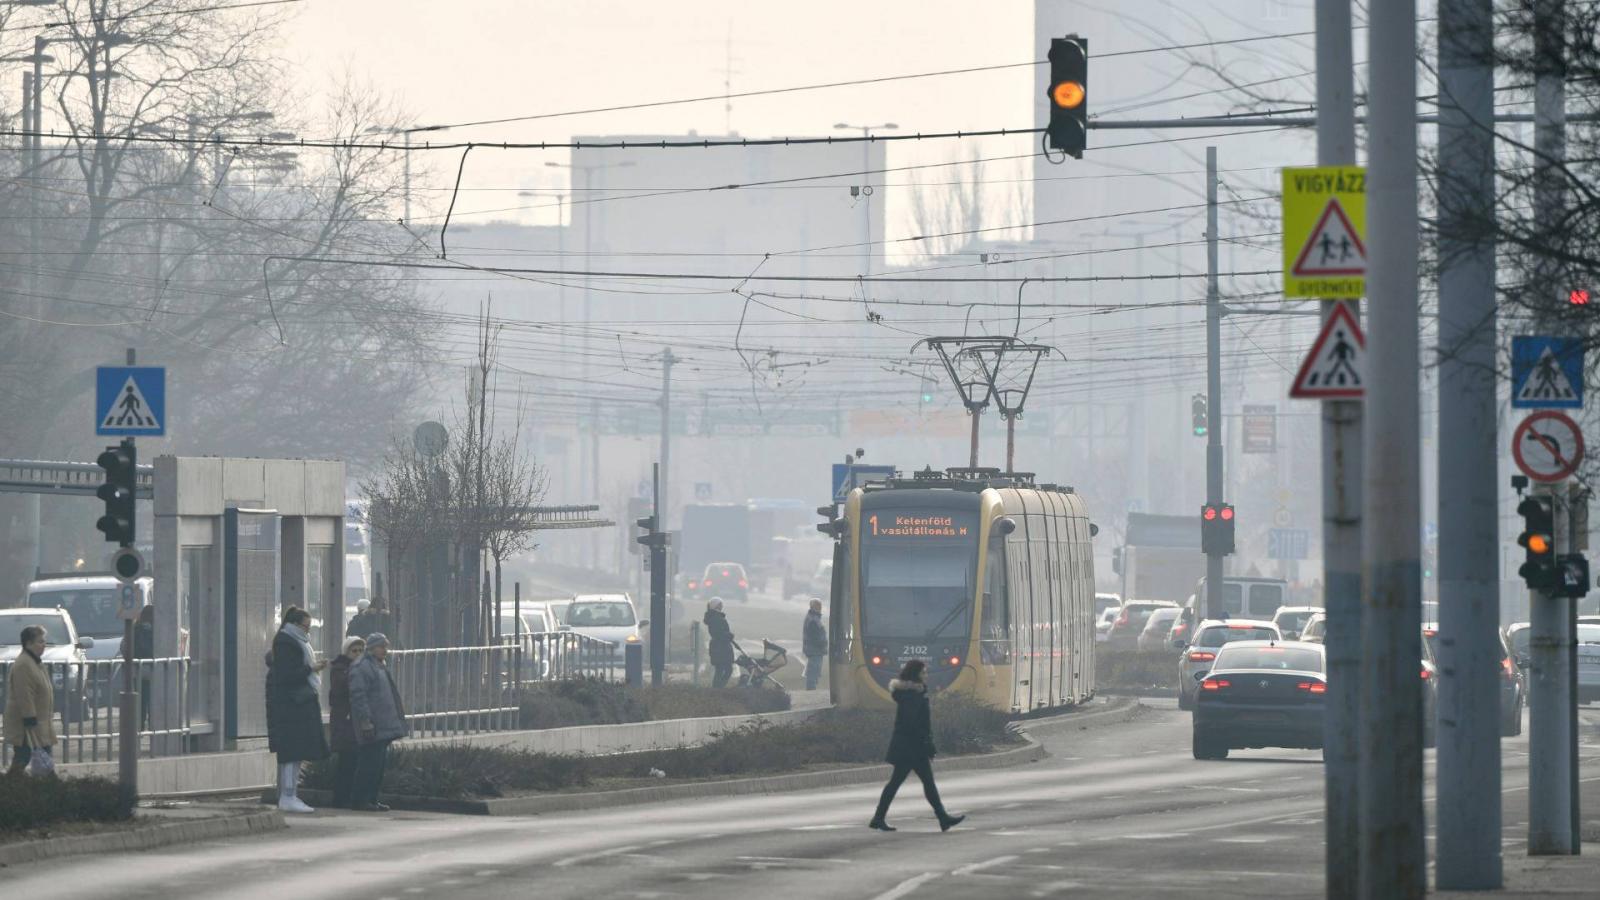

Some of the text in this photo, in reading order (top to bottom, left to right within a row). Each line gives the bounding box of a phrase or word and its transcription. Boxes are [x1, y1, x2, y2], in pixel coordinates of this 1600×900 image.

[1298, 280, 1364, 295] GYERMEKE
[869, 515, 878, 536] 1
[896, 517, 951, 525] Kelenföld
[903, 645, 928, 655] 2102
